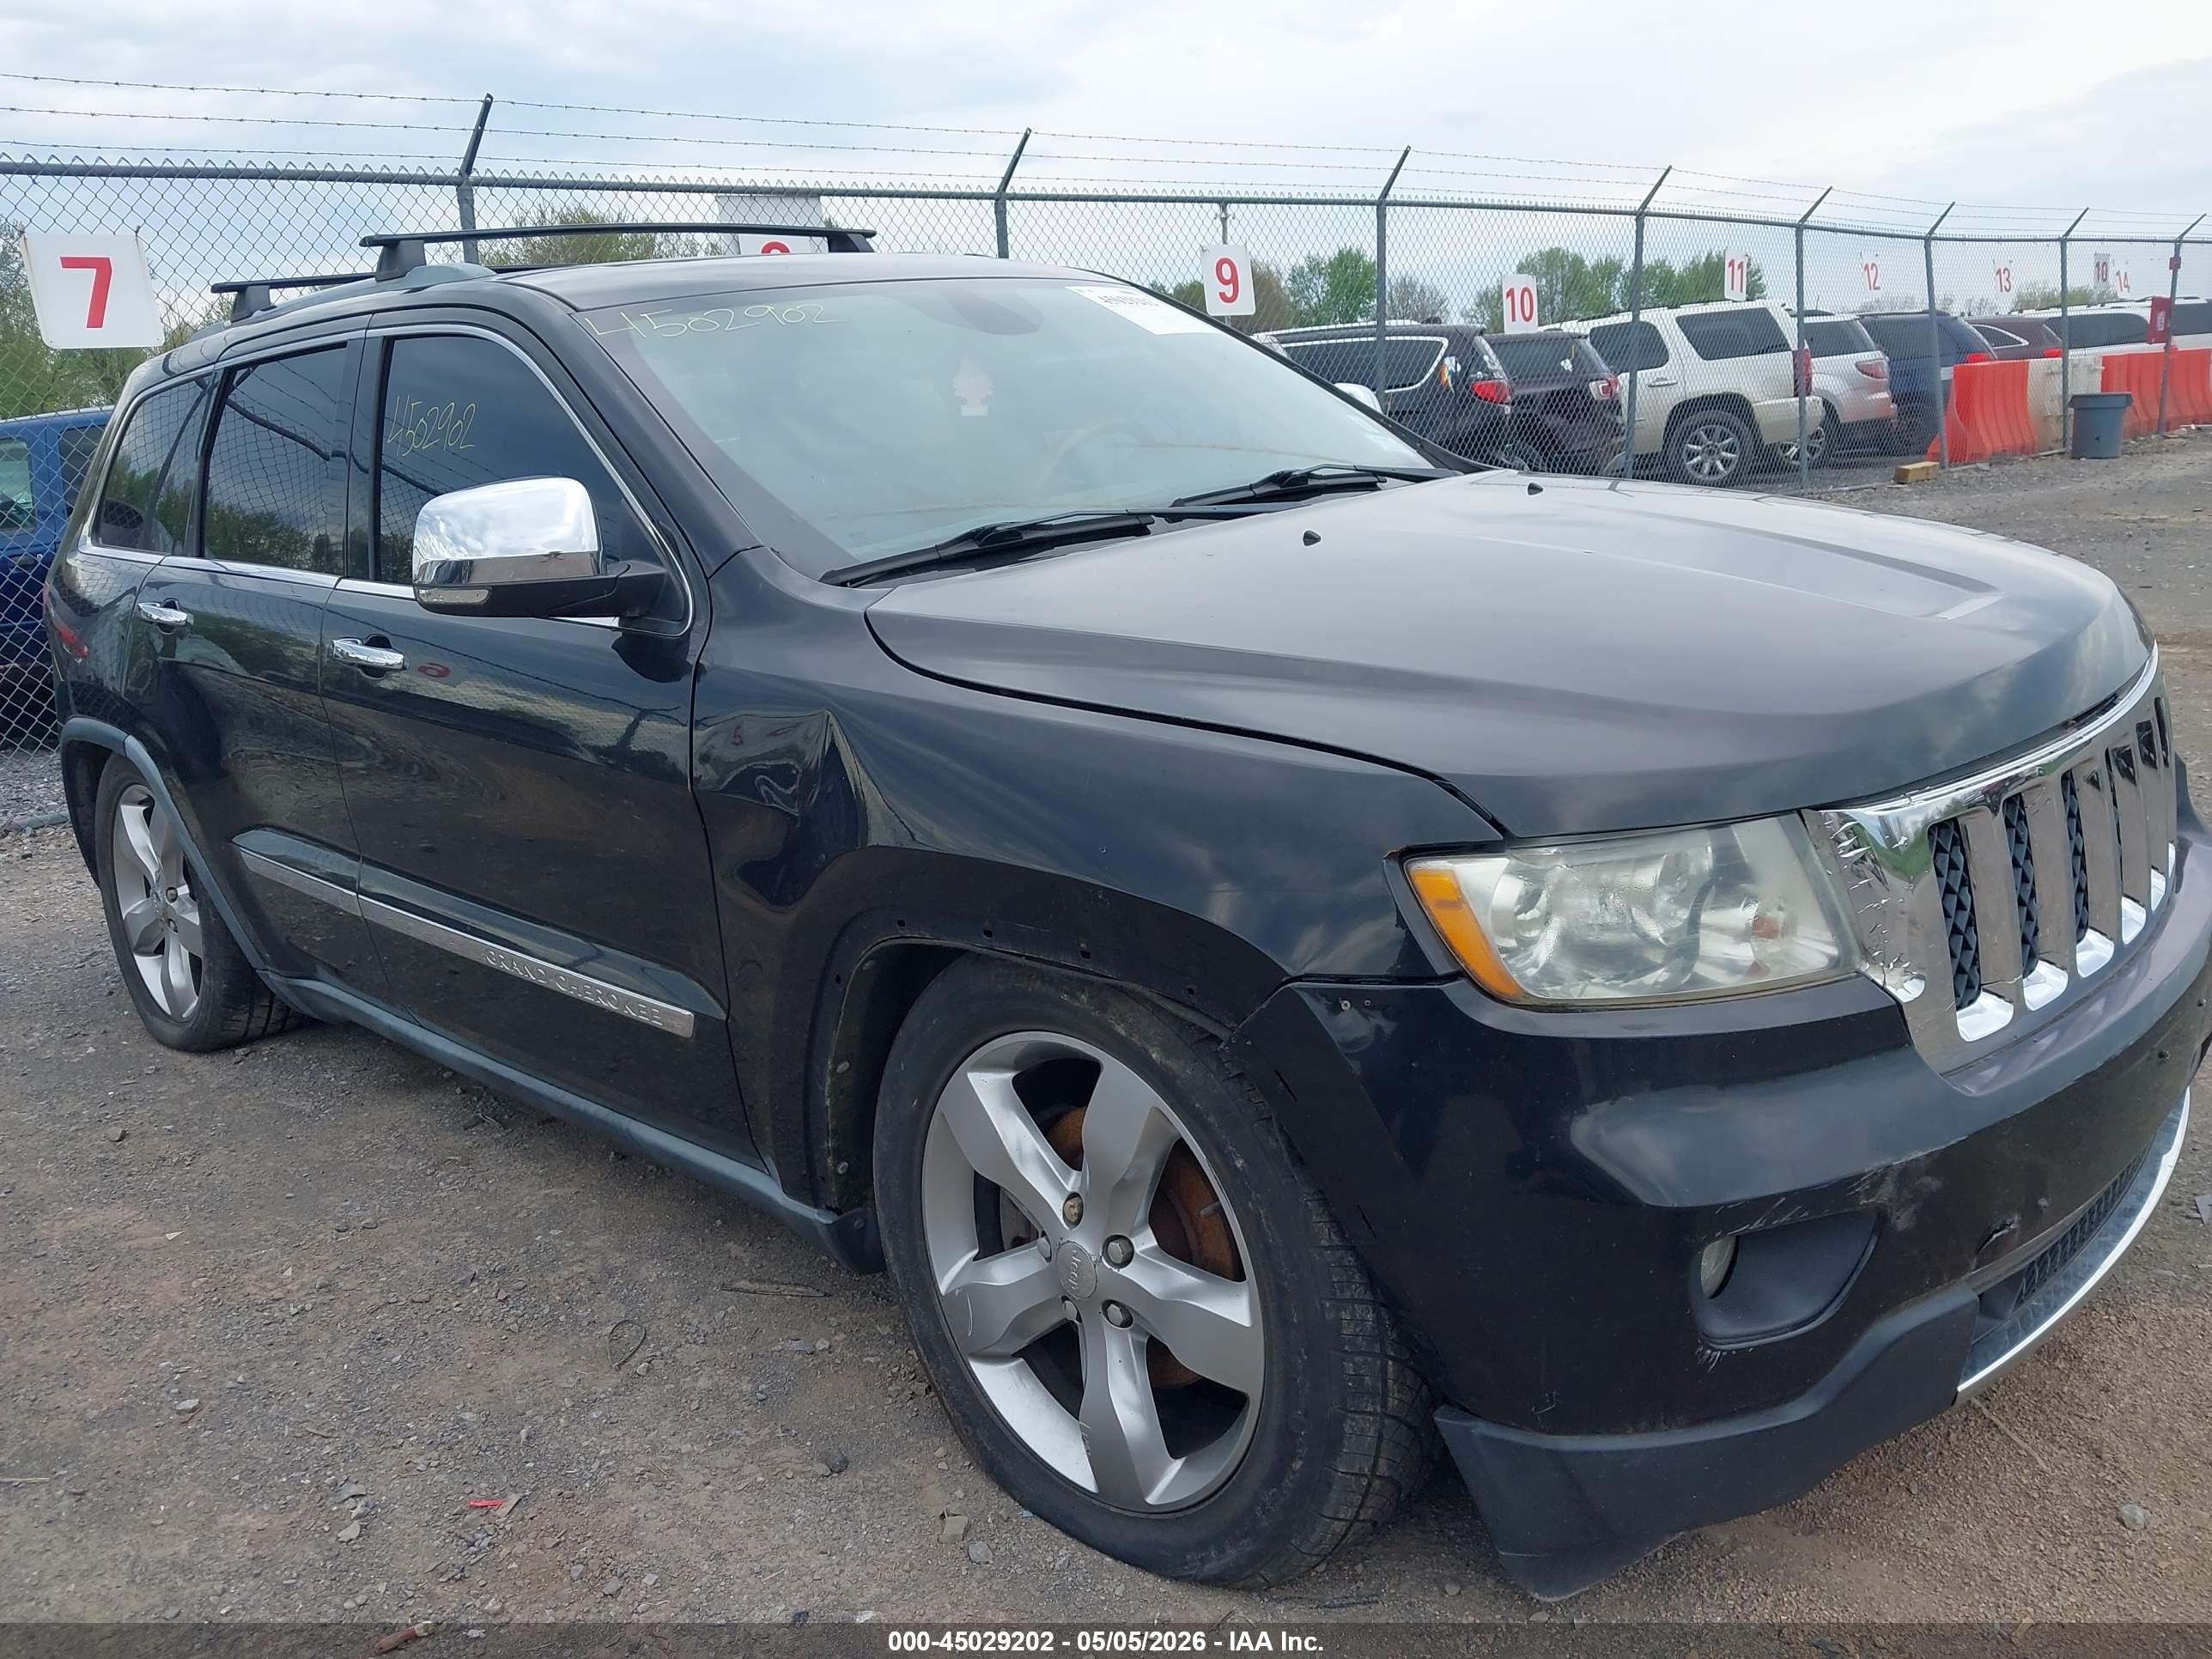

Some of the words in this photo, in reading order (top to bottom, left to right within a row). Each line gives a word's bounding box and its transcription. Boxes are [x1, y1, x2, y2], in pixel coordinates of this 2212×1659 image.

[1215, 257, 1240, 304] 9
[1728, 258, 1745, 294] 11
[1863, 262, 1881, 291] 12
[1996, 267, 2012, 293] 13
[2094, 260, 2109, 283] 10
[2115, 270, 2130, 293] 14
[59, 256, 112, 328] 7
[1505, 286, 1534, 324] 10
[584, 303, 848, 339] 4502902
[386, 394, 476, 458] 4502902
[485, 950, 547, 984] GRAND
[556, 975, 665, 1026] CHEROKEE
[1066, 1249, 1082, 1290] Jeep
